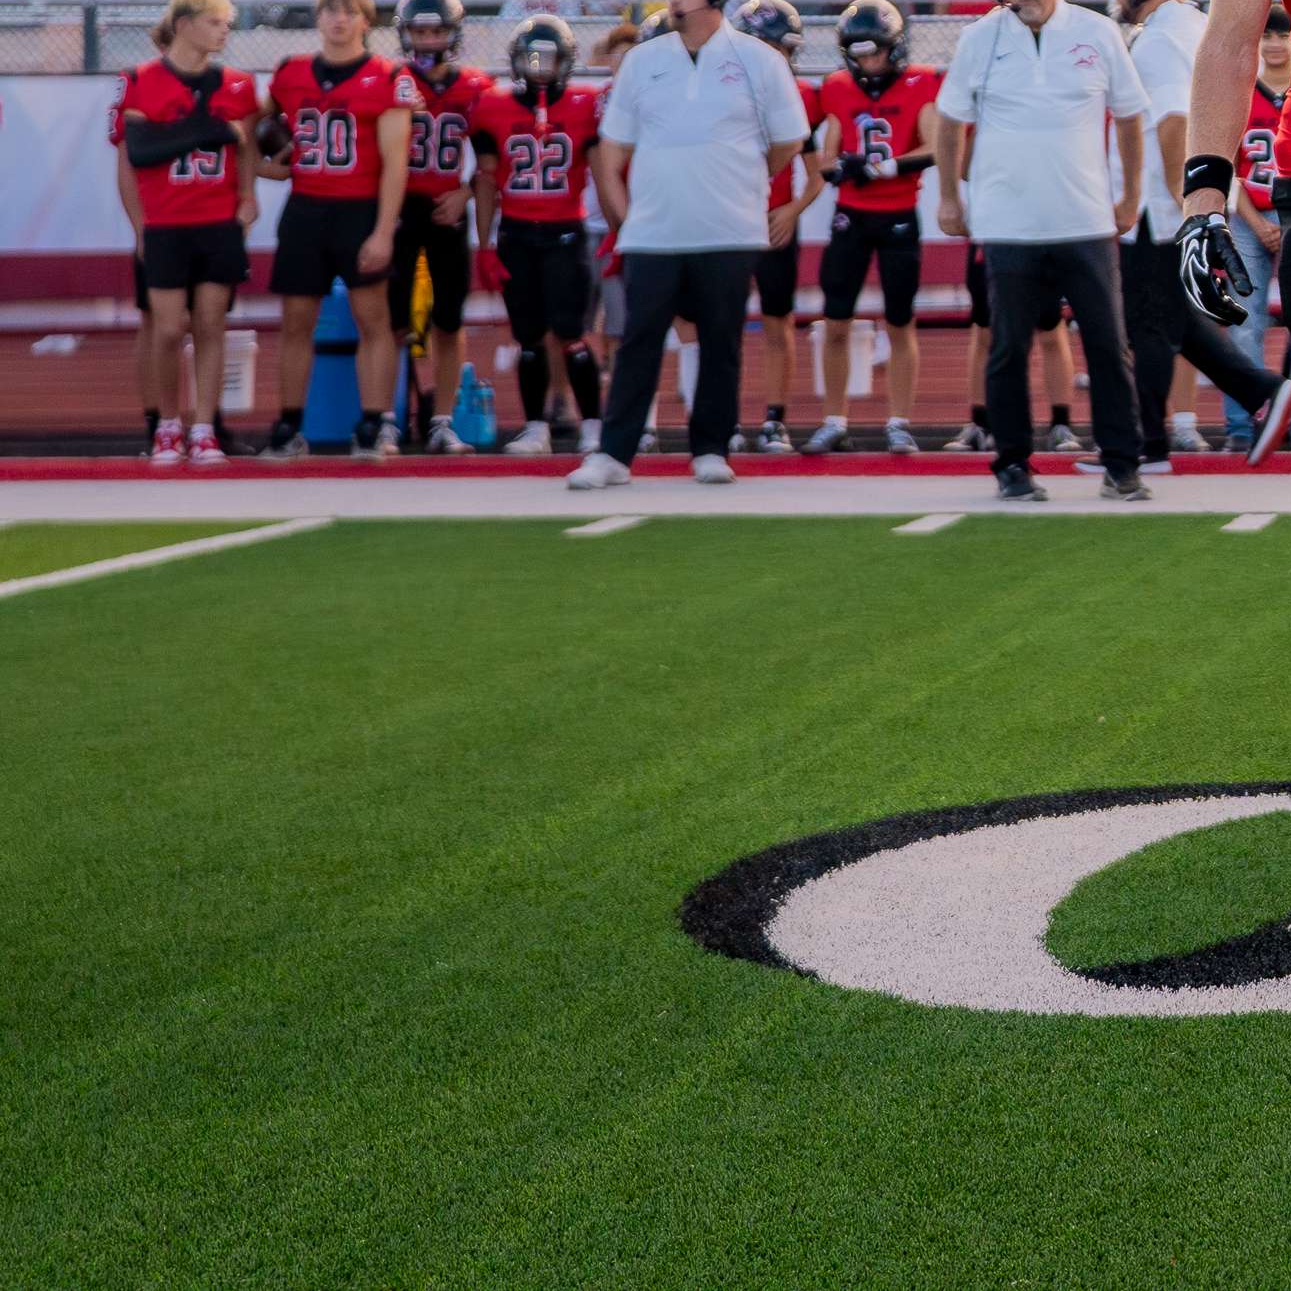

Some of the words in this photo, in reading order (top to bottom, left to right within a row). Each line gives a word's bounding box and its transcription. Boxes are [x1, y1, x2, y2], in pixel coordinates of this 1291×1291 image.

[294, 108, 357, 173] 20
[407, 111, 469, 173] 36
[504, 132, 573, 196] 22
